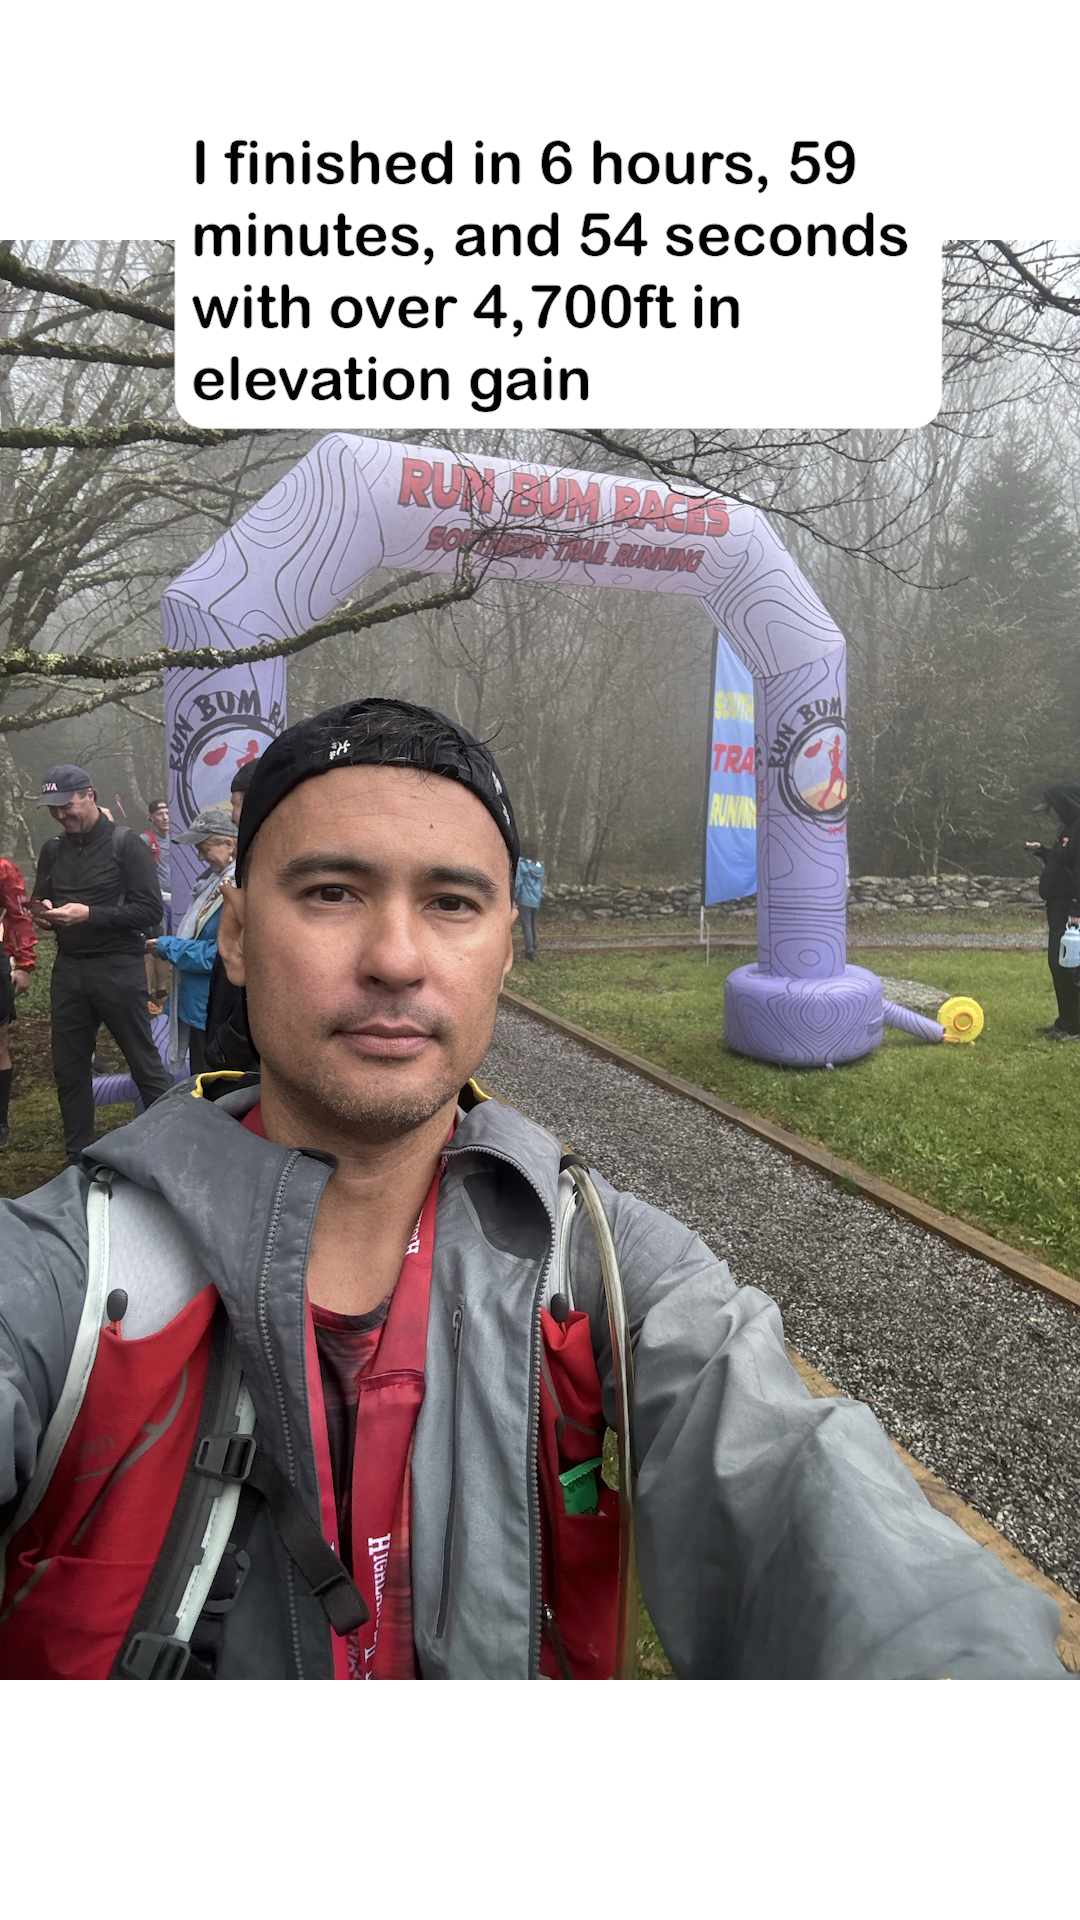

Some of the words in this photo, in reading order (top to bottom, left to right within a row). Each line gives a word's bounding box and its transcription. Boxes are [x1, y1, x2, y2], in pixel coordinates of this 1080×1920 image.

[398, 457, 495, 515] RUN
[508, 472, 600, 525] BUM
[613, 485, 729, 537] RACES
[553, 536, 610, 565] TRAIL
[610, 543, 705, 572] RUNNING
[169, 714, 194, 772] RUN
[193, 689, 261, 722] BUM
[768, 723, 797, 768] RUN
[797, 697, 841, 725] BUM
